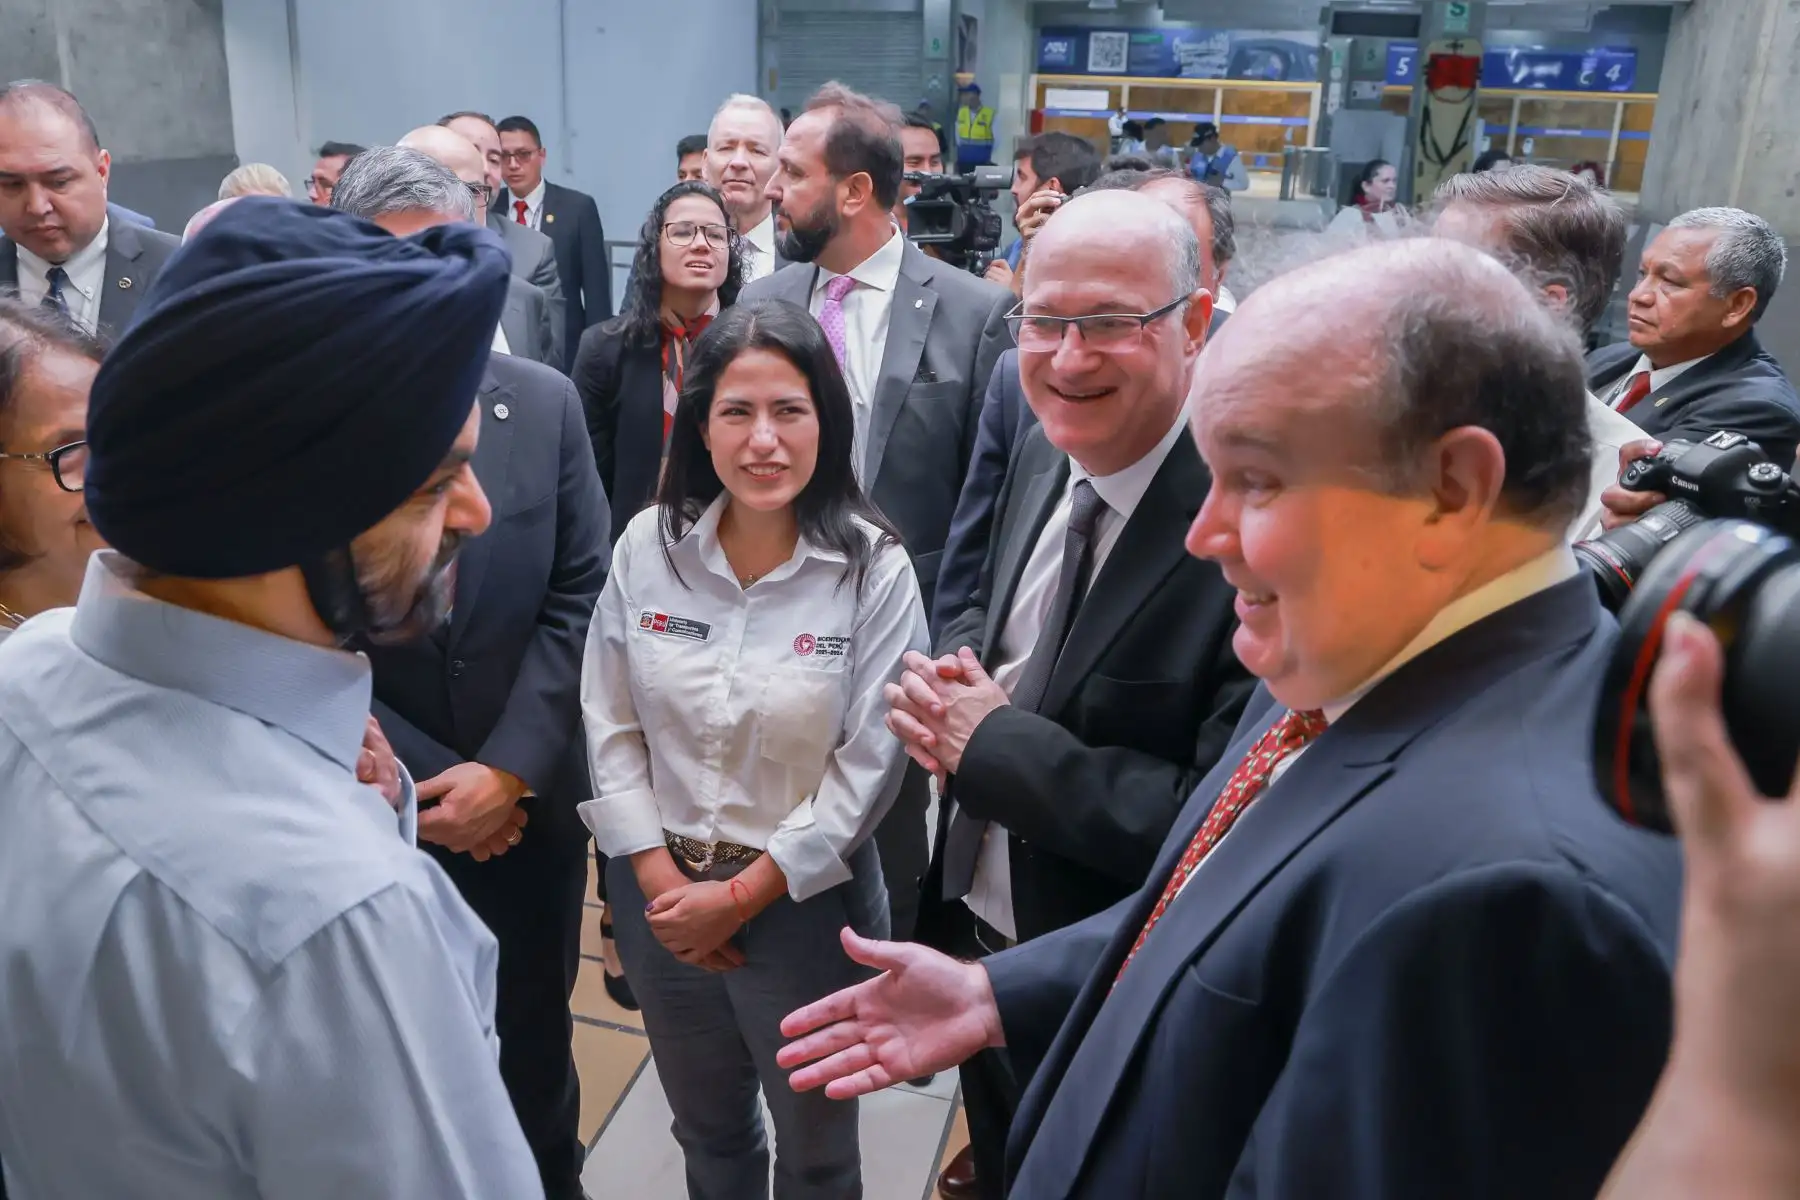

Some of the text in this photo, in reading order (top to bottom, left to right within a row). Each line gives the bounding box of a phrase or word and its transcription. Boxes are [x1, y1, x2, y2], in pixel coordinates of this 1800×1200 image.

[1449, 0, 1466, 17] S
[1395, 57, 1412, 76] 5
[1604, 64, 1622, 82] 4
[1671, 475, 1699, 492] Canon
